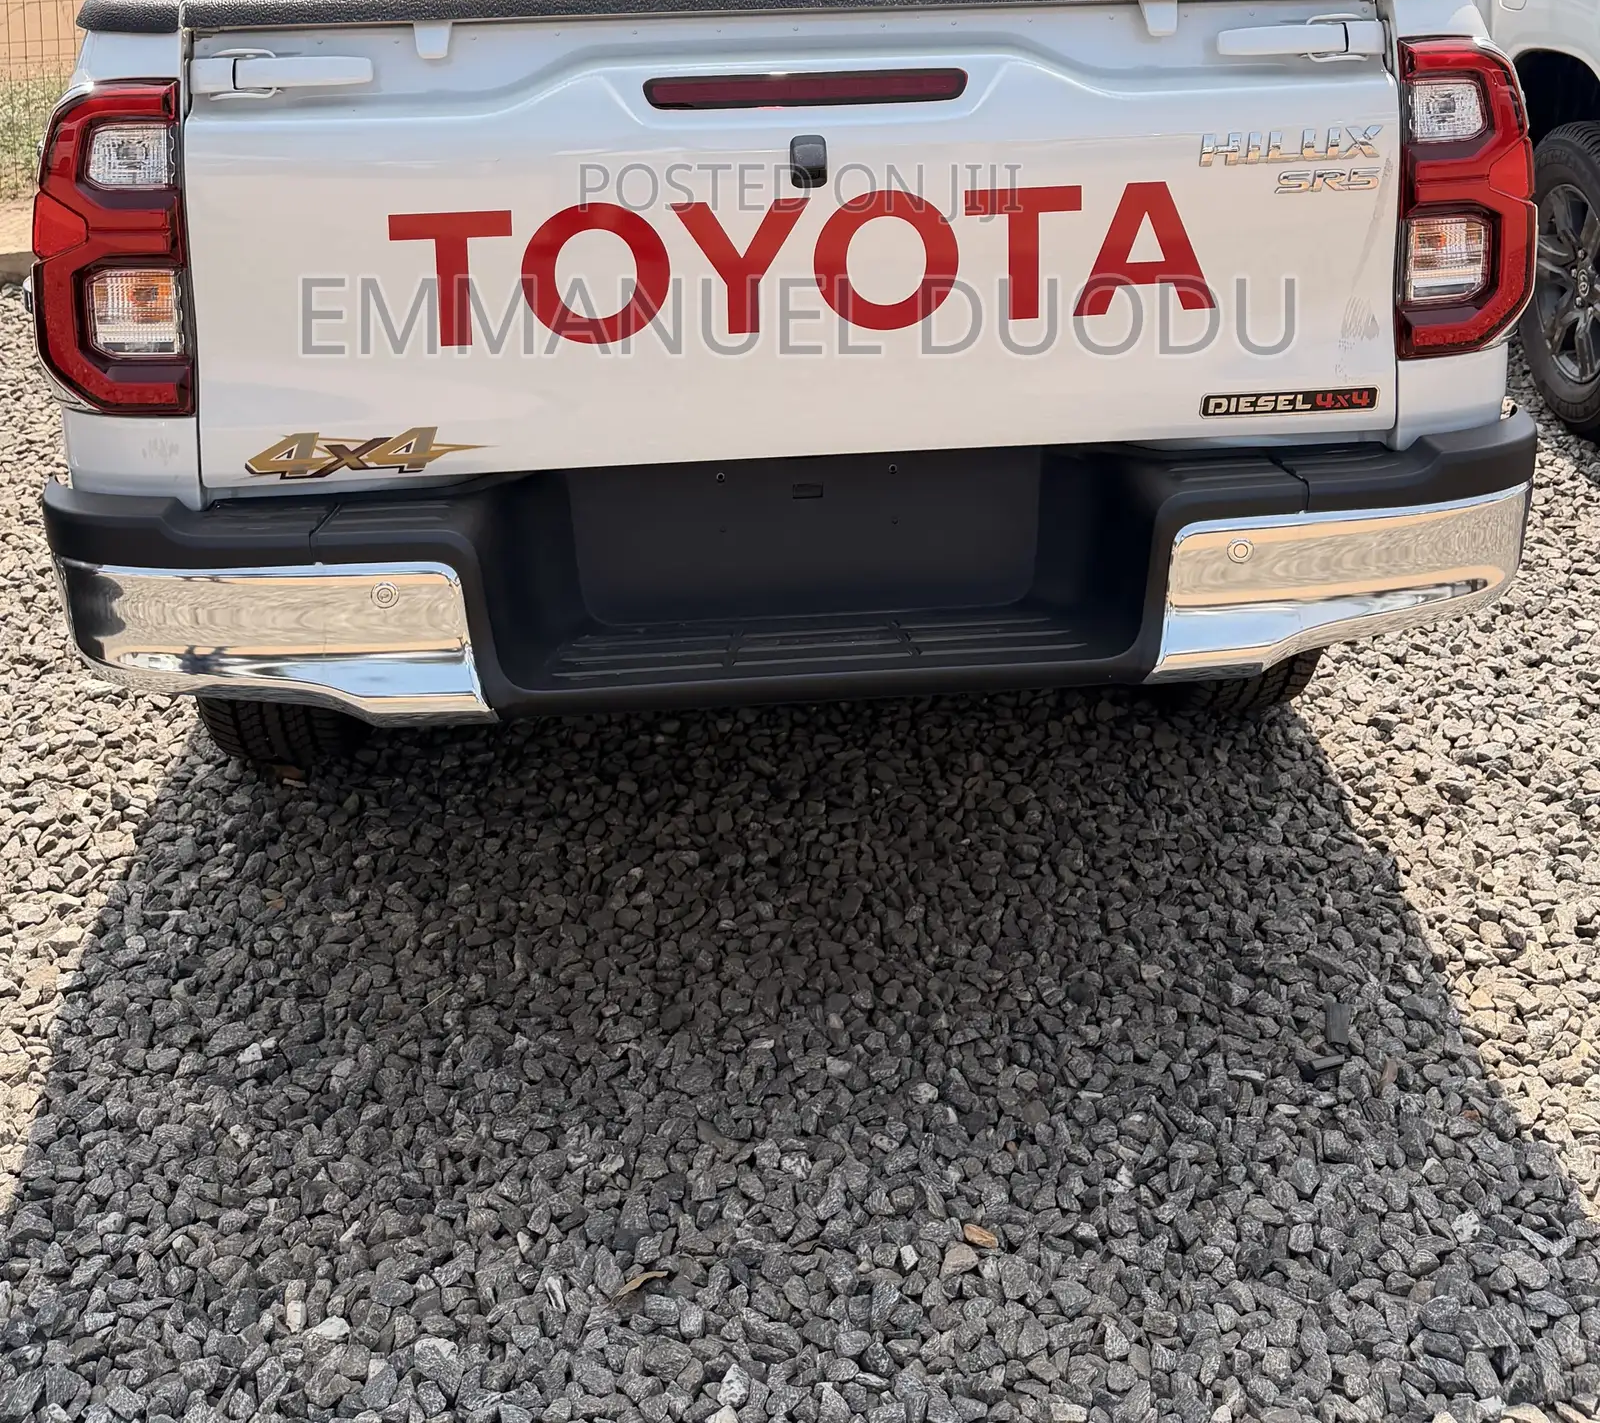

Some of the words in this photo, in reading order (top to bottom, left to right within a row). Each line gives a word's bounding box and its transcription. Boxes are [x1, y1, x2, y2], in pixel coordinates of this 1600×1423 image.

[1199, 124, 1384, 168] HILUX
[1274, 166, 1382, 194] SR5
[387, 180, 1217, 347] TOYOTA
[1207, 393, 1312, 415] DIESEL
